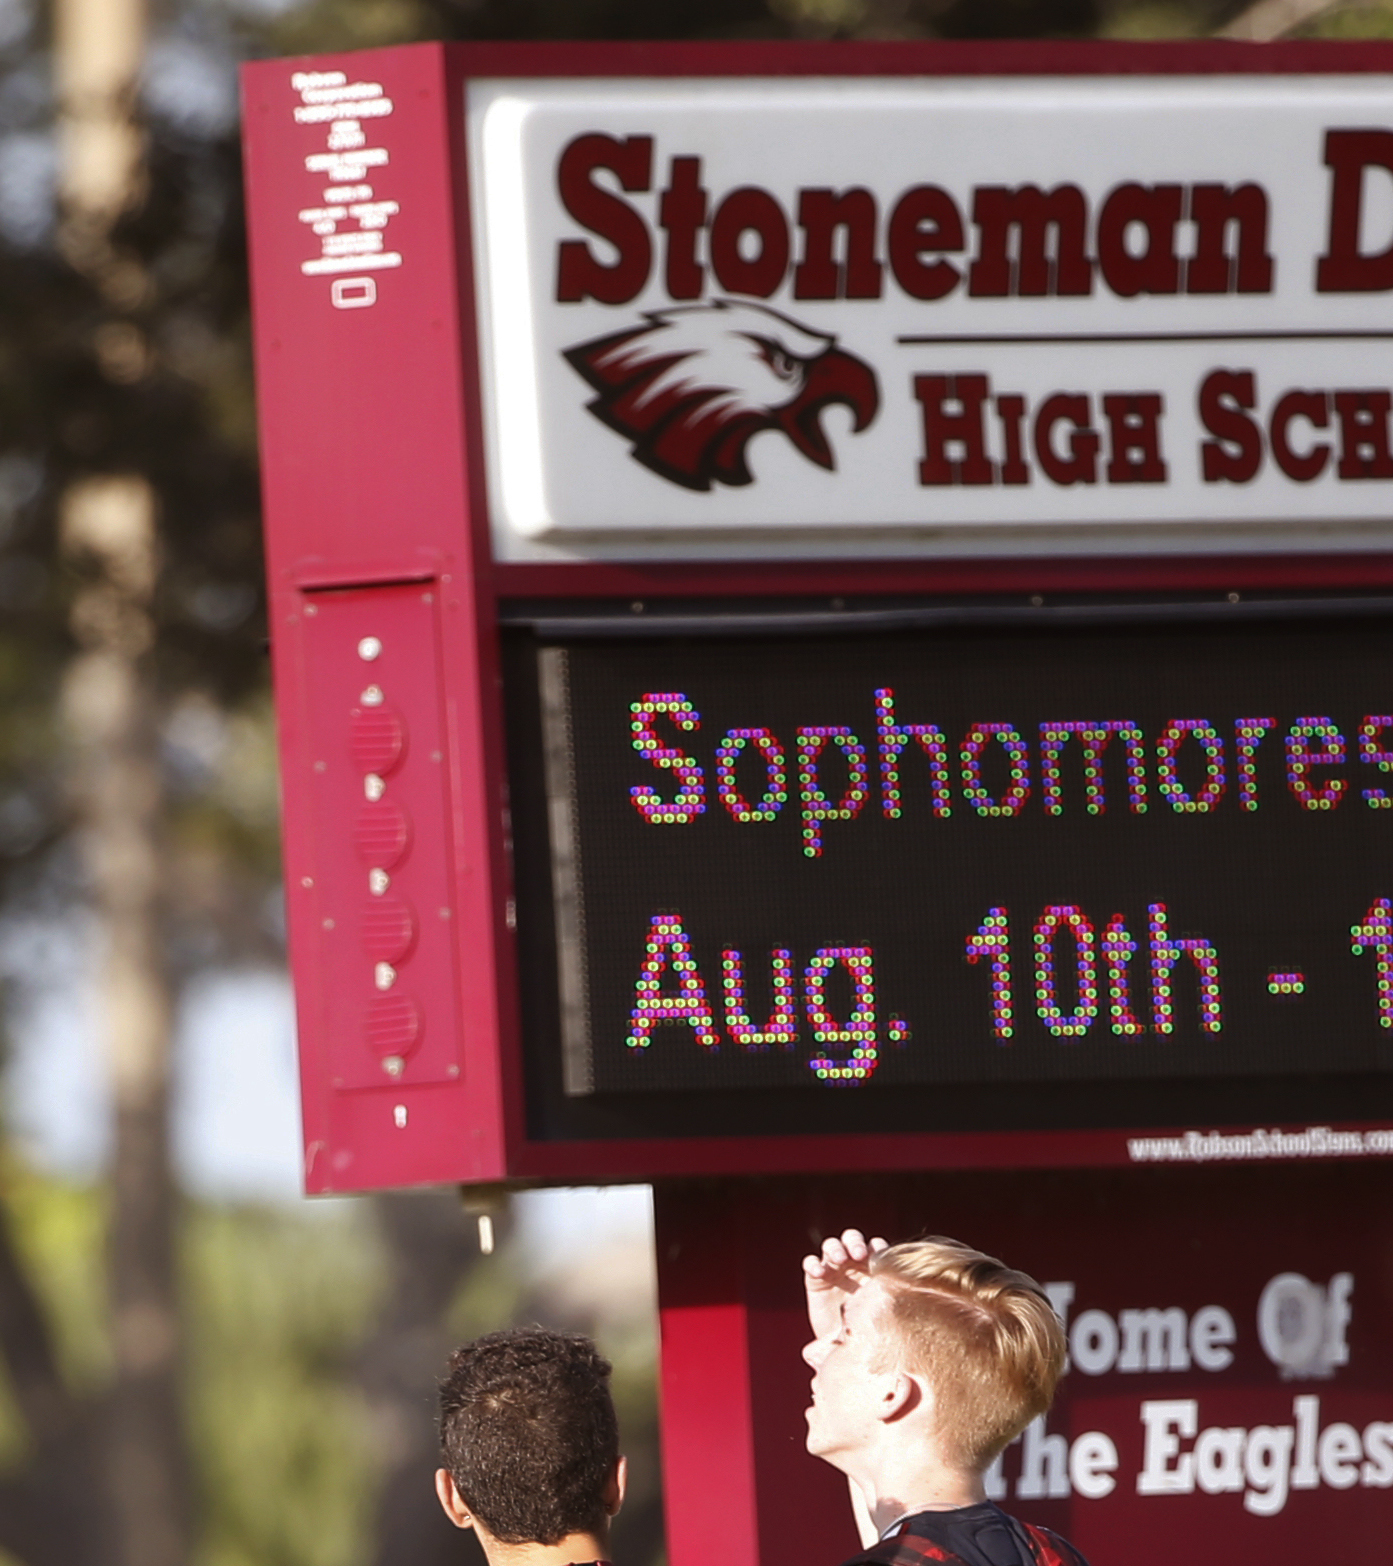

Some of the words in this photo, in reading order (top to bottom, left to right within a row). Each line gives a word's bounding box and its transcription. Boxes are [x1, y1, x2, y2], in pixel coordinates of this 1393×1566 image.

[556, 132, 1276, 305] Stoneman
[912, 372, 1168, 487] HIGH
[625, 912, 910, 1084] Aug.
[965, 902, 1222, 1040] 10th
[1256, 1271, 1355, 1372] Of
